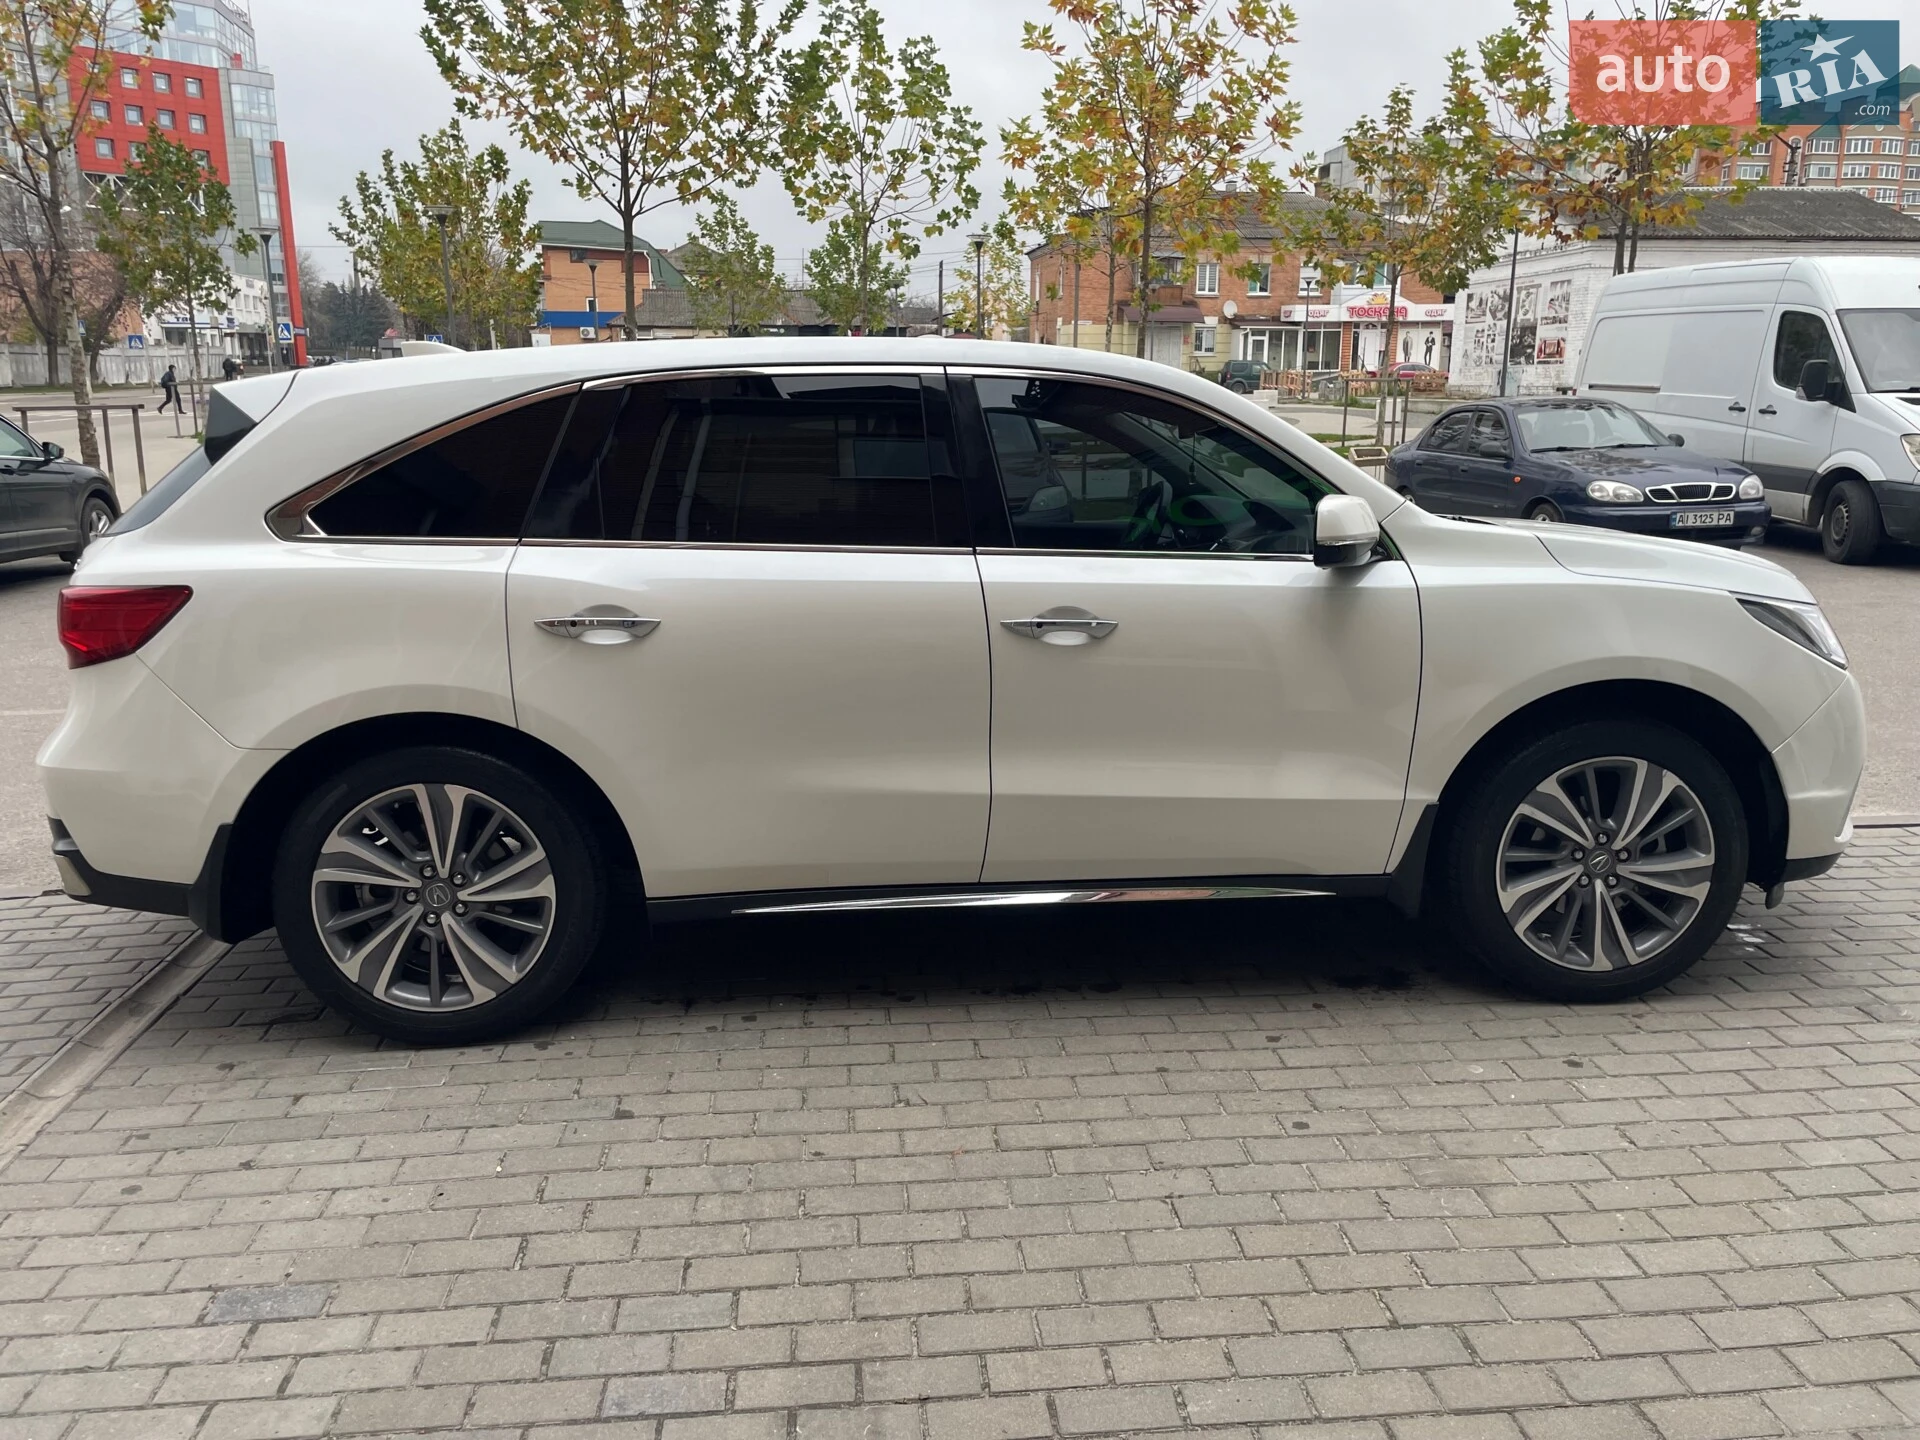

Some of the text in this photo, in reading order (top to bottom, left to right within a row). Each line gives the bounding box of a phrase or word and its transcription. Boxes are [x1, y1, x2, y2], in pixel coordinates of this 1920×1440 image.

[1677, 513, 1732, 525] AI 3125 PA
